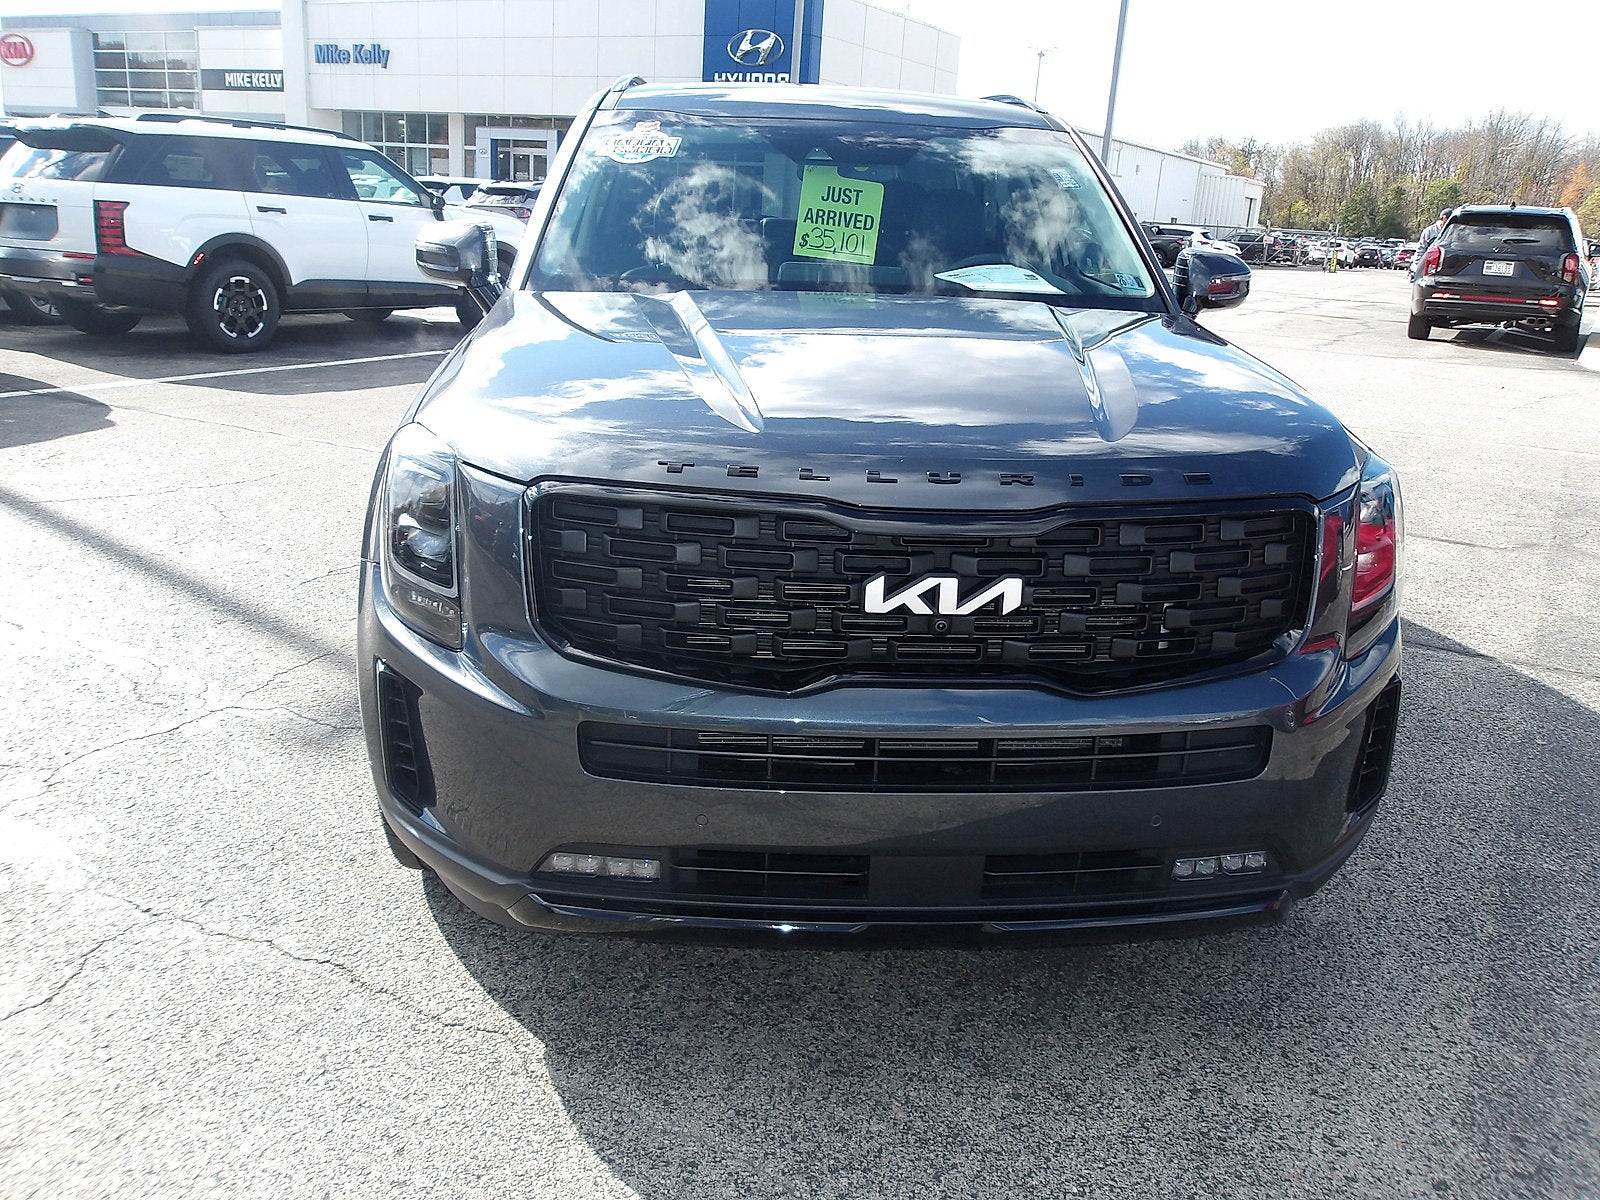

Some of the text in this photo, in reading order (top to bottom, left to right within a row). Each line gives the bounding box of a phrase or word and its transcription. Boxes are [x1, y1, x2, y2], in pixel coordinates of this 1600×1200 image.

[0, 40, 28, 59] KIA
[314, 43, 391, 70] Mike Kelly
[224, 72, 283, 88] MIKE KELLY
[714, 72, 790, 83] HYUNDA
[820, 185, 864, 206] JUST
[802, 207, 875, 231] ARRIVED
[657, 461, 1213, 486] TELLURIDE
[864, 574, 1023, 616] KIA
